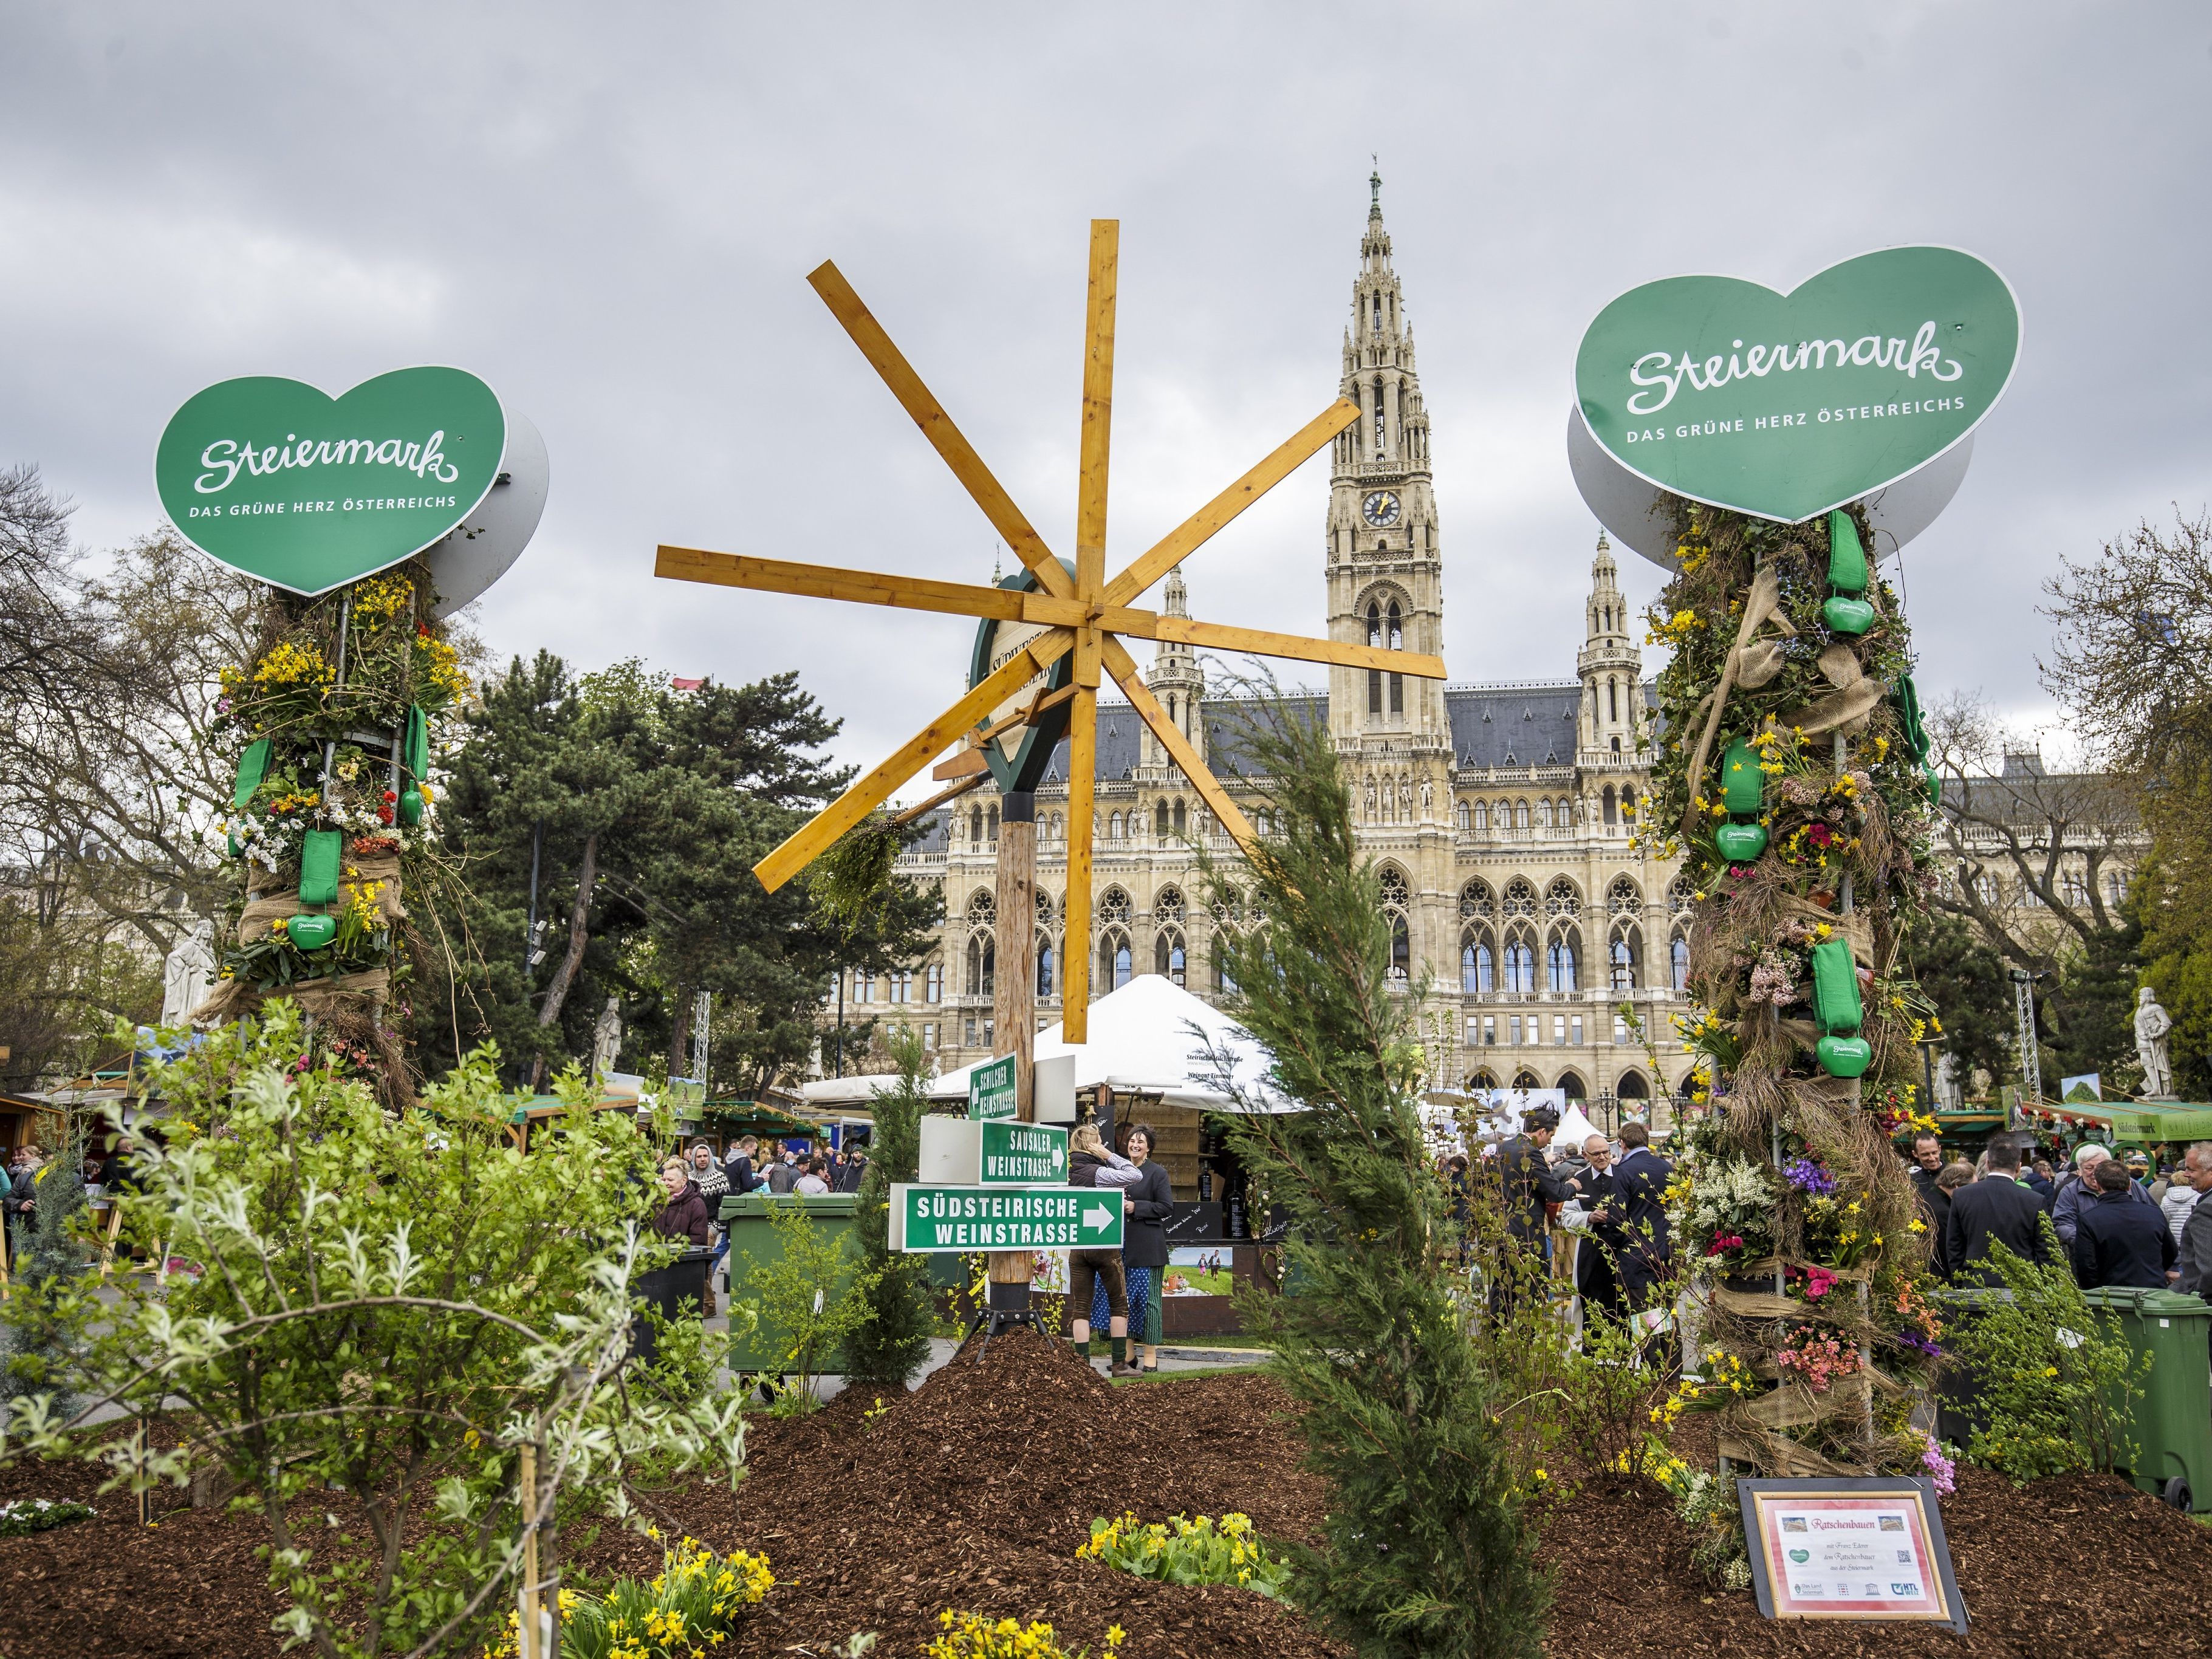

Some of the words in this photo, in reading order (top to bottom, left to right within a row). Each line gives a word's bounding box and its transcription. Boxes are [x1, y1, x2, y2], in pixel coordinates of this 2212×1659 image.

[1626, 321, 1963, 415] Steiermark
[1627, 428, 1665, 443] DAS
[1676, 419, 1744, 439] GRÜNE
[1755, 413, 1807, 430] HERZ
[1817, 397, 1965, 423] ÖSTERREICHS
[194, 430, 459, 494] Steiermark
[189, 505, 222, 518] DAS
[230, 499, 285, 515] GRÜNE
[293, 499, 335, 513] HERZ
[343, 496, 456, 511] ÖSTERREICHS
[980, 1065, 1007, 1092] SCHILCHER
[979, 1089, 1014, 1115] WEINSTRASSE
[2118, 1123, 2156, 1134] Südsteiermark
[1010, 1130, 1051, 1152] SAUSALER
[987, 1155, 1051, 1177] WEINSTRASSE
[917, 1192, 1078, 1218] SÜDSTEIRISCHE
[935, 1223, 1078, 1244] WEINSTRASSE
[1811, 1519, 1875, 1530] Ratschenbauen
